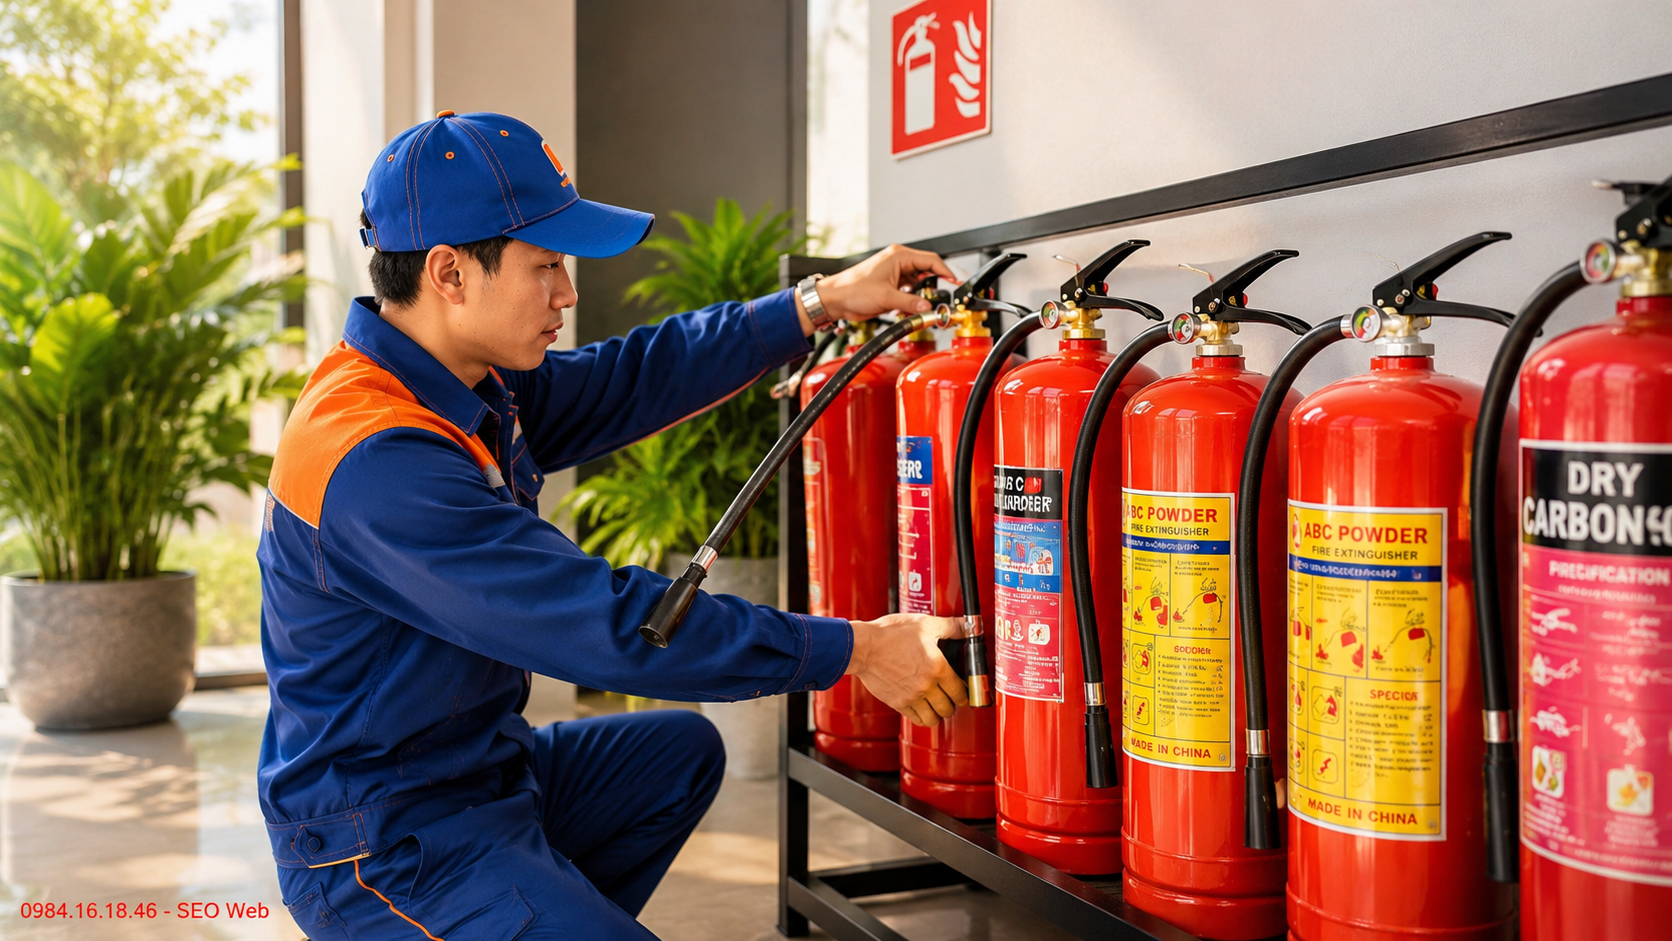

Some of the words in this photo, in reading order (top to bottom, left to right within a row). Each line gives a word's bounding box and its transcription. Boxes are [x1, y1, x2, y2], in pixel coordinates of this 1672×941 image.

[1567, 460, 1645, 498] DRY
[1147, 506, 1218, 523] POWDER
[1145, 525, 1210, 536] EXTINGUISHER
[1304, 522, 1333, 540] ABC
[1338, 525, 1428, 544] POWDER
[1312, 545, 1331, 557] FIRE
[1334, 548, 1418, 560] EXTINGUISHER
[1157, 744, 1169, 755] IN
[1173, 746, 1211, 759] CHINA
[1307, 798, 1342, 817] MADE
[1347, 807, 1362, 820] IN
[1368, 810, 1418, 825] CHINA
